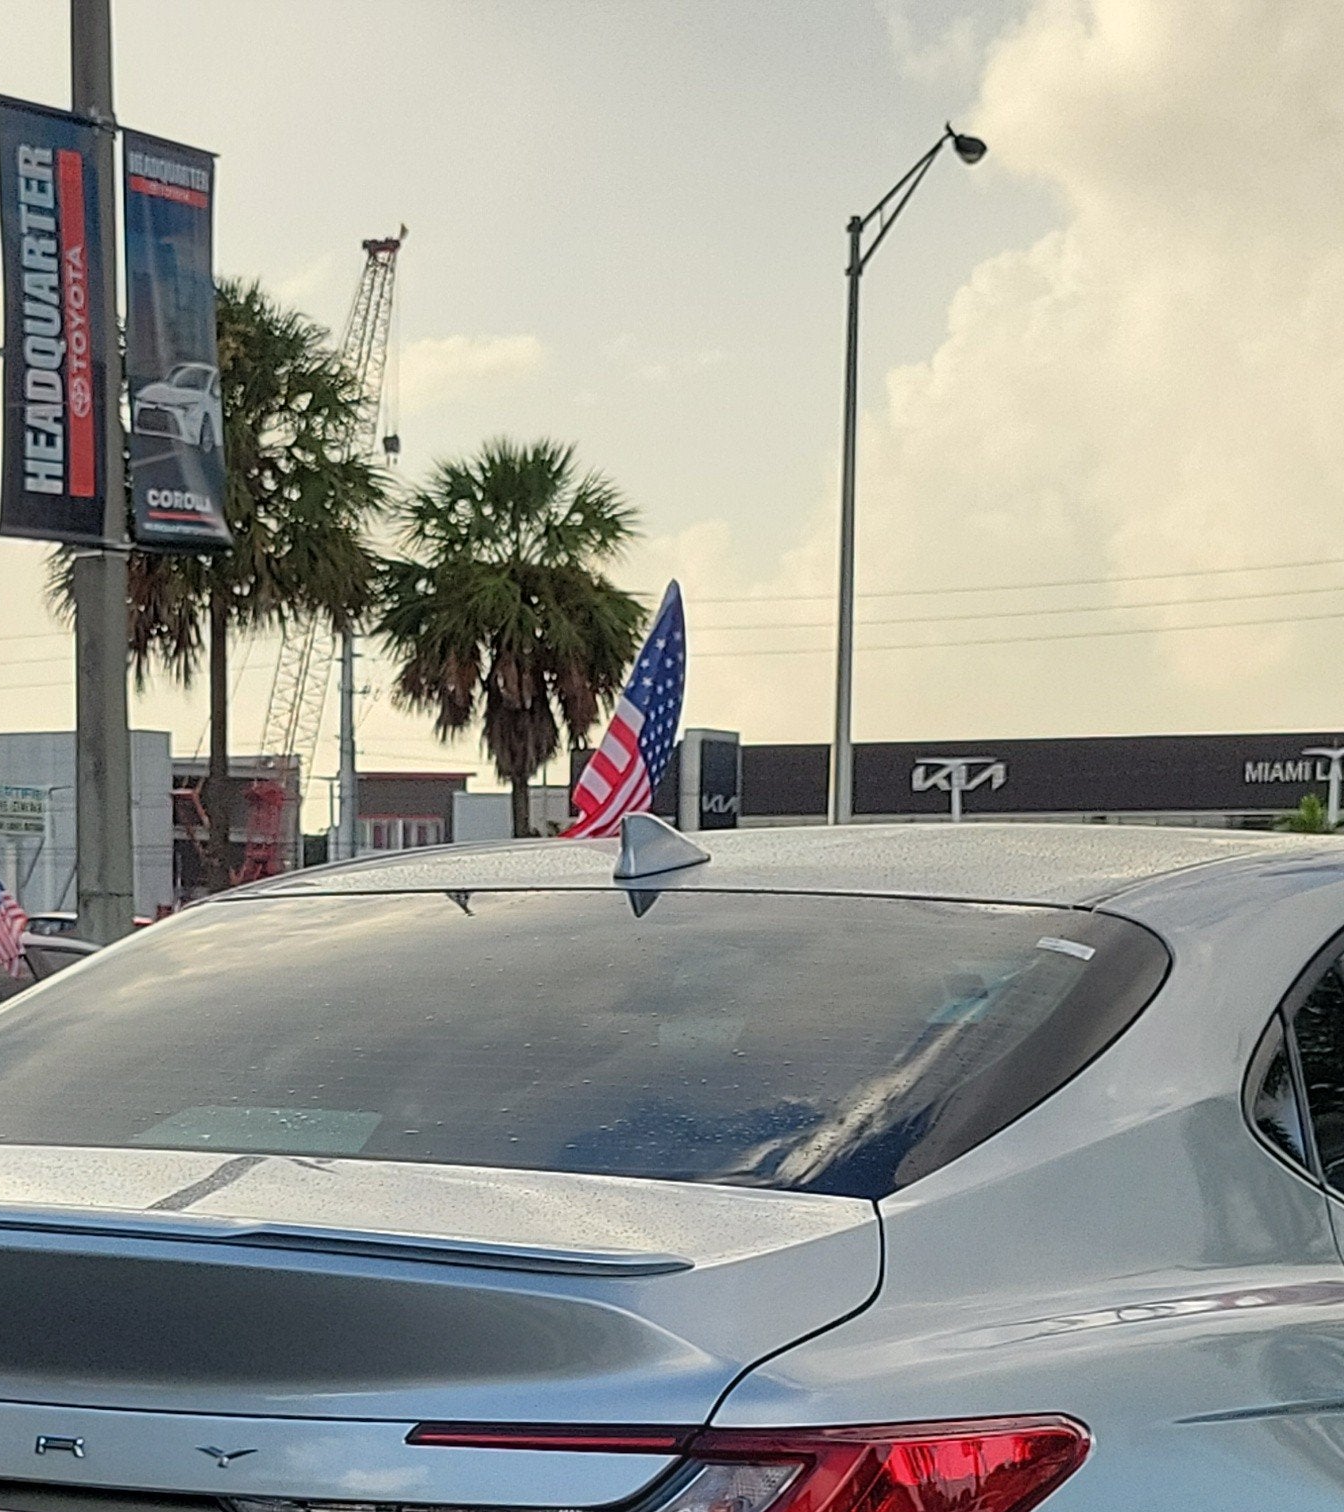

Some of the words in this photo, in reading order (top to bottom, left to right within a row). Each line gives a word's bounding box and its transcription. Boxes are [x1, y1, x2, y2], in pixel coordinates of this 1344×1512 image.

[18, 145, 67, 495] HEADQUARTER
[64, 246, 87, 374] TOYOTA
[1244, 761, 1311, 783] MIAMI
